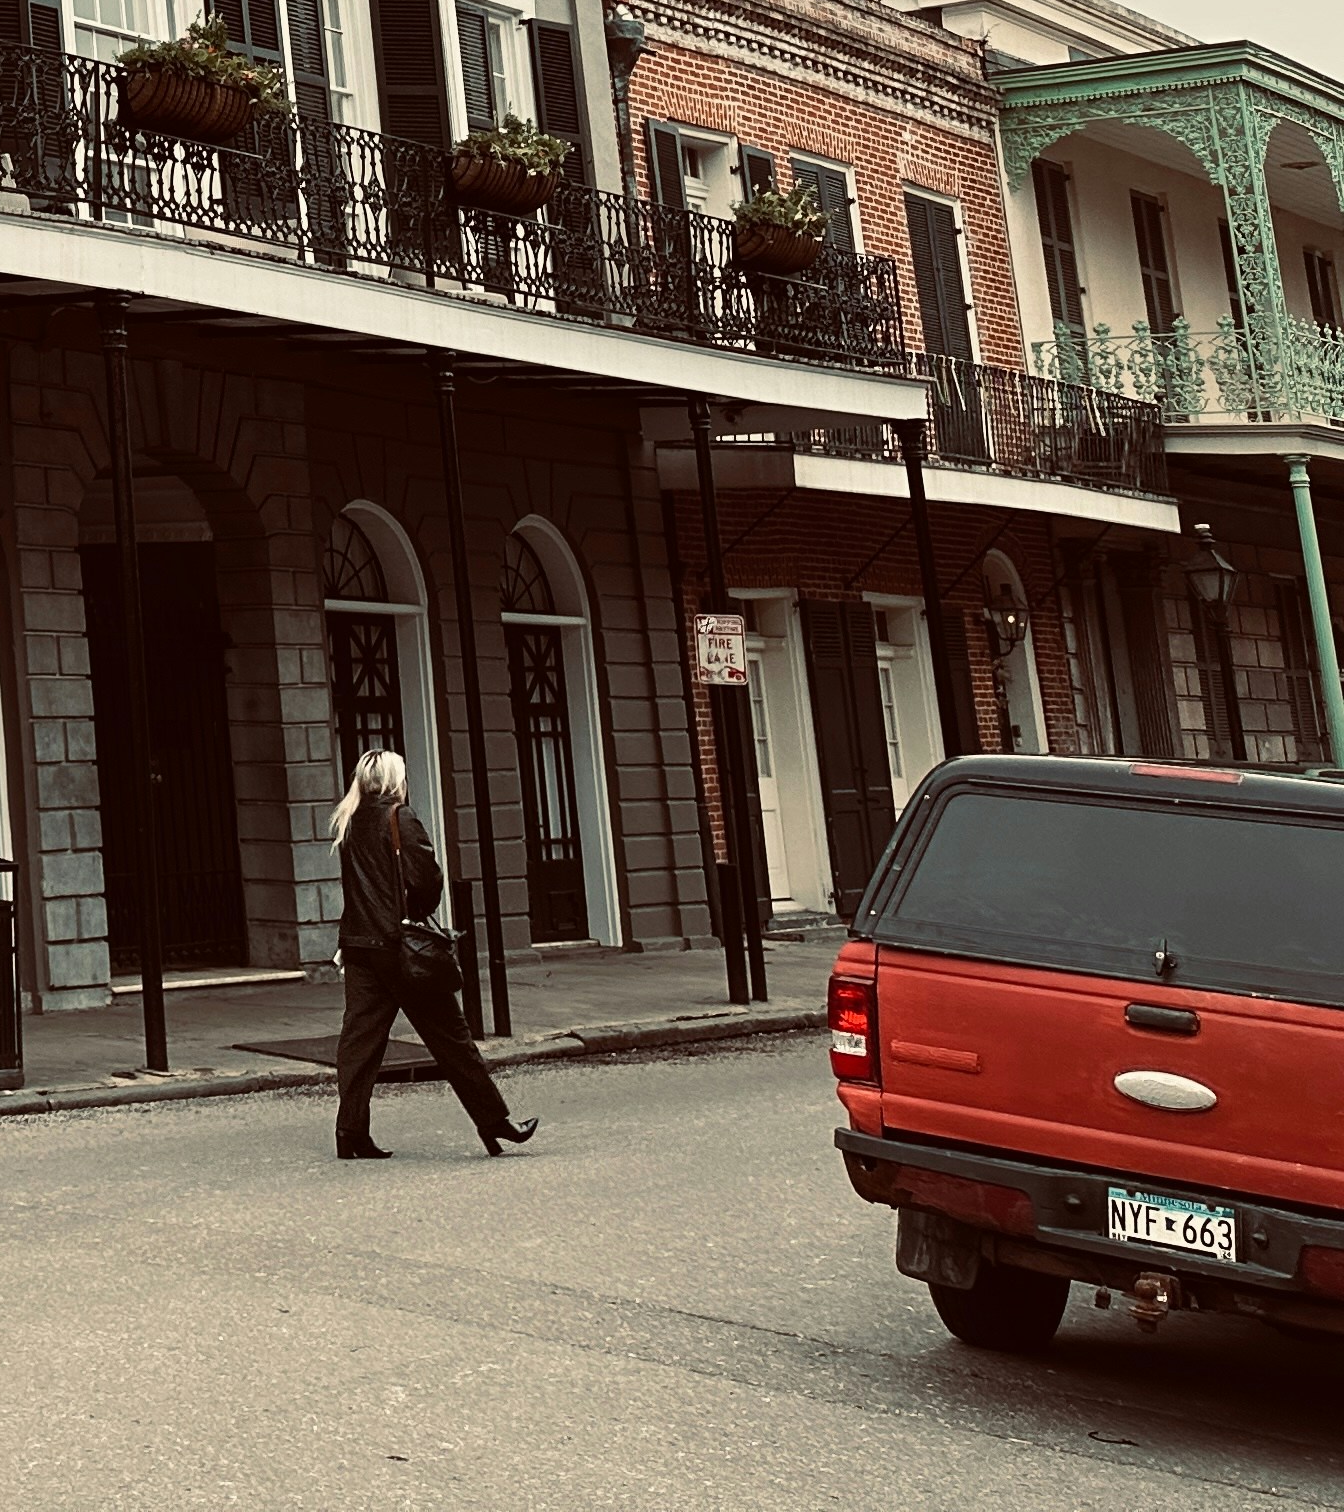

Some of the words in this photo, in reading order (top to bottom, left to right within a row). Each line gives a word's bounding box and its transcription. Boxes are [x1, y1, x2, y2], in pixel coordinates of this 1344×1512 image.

[708, 638, 732, 649] FIRE
[1111, 1199, 1160, 1236] NYF
[1182, 1213, 1233, 1251] 663
